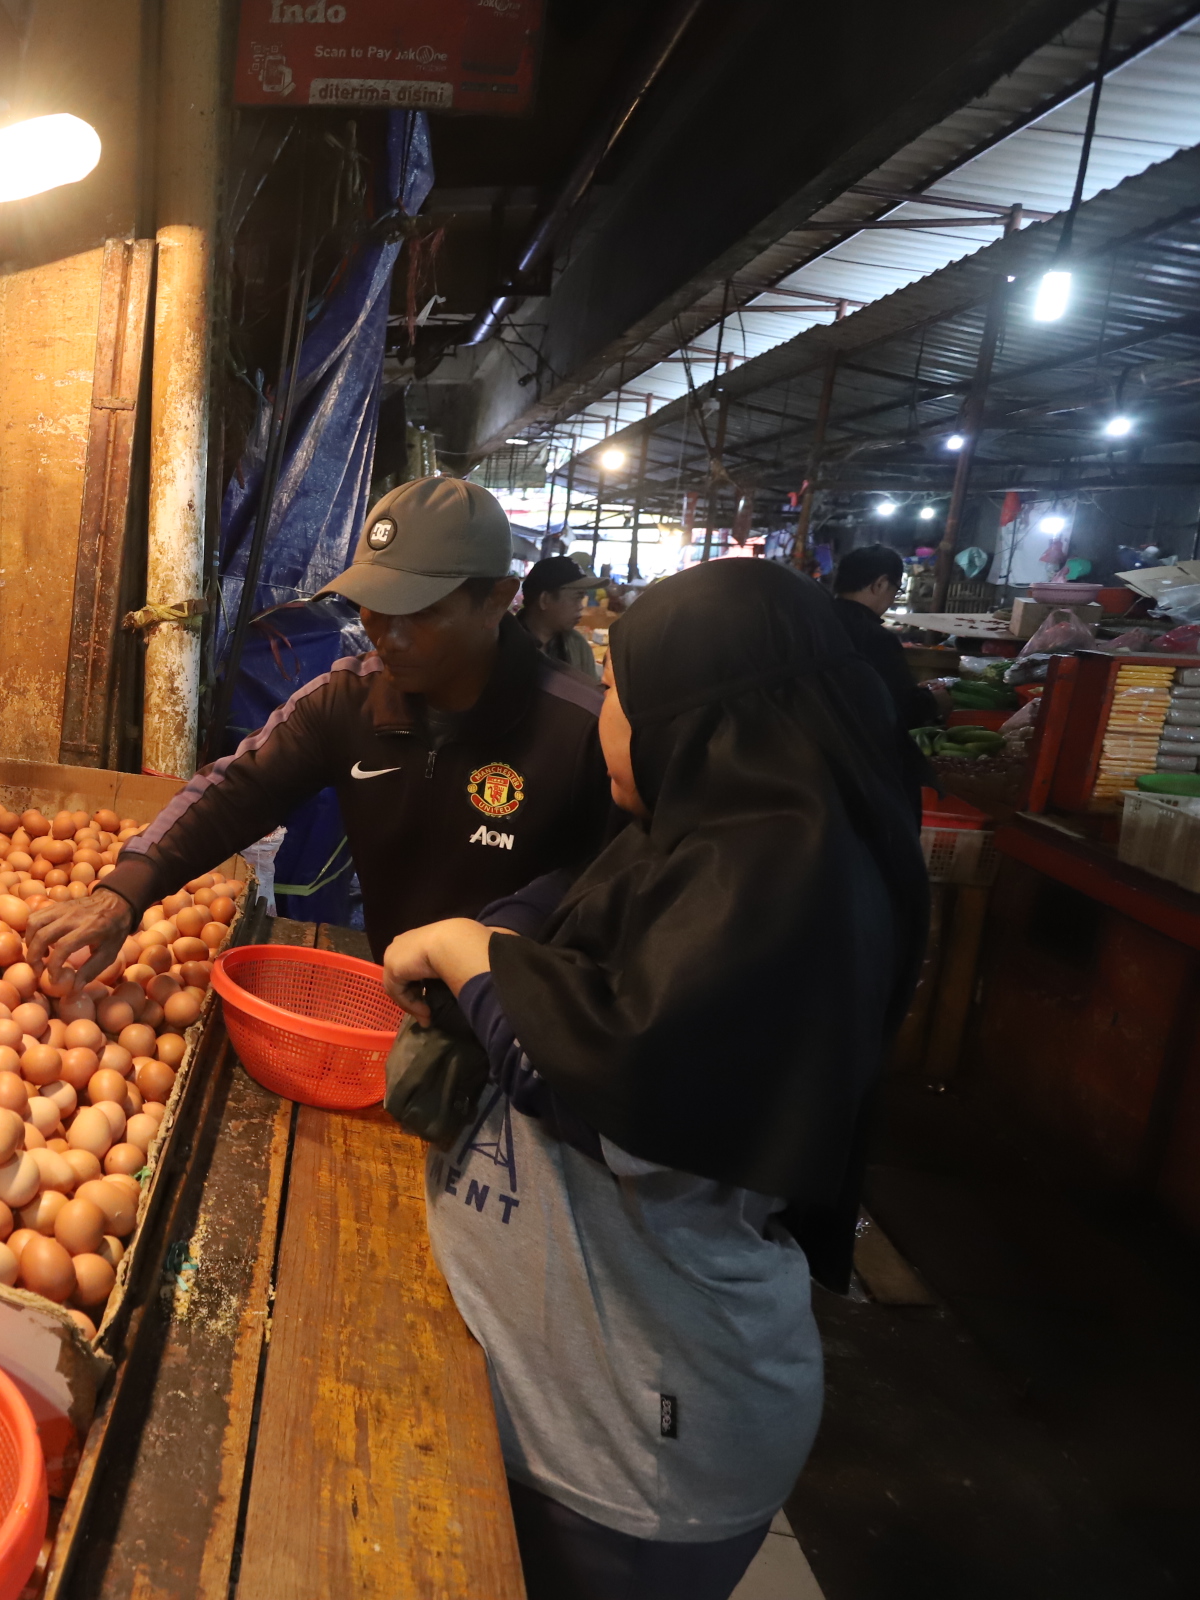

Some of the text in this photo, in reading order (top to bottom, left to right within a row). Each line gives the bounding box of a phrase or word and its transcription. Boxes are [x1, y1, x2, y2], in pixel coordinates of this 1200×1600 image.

[314, 45, 346, 58] Scan
[351, 46, 363, 58] to
[368, 46, 392, 61] Pay
[319, 84, 444, 102] diterima disini
[475, 766, 520, 786] MANCHESTER
[478, 801, 511, 813] UNITED
[469, 825, 514, 850] AON
